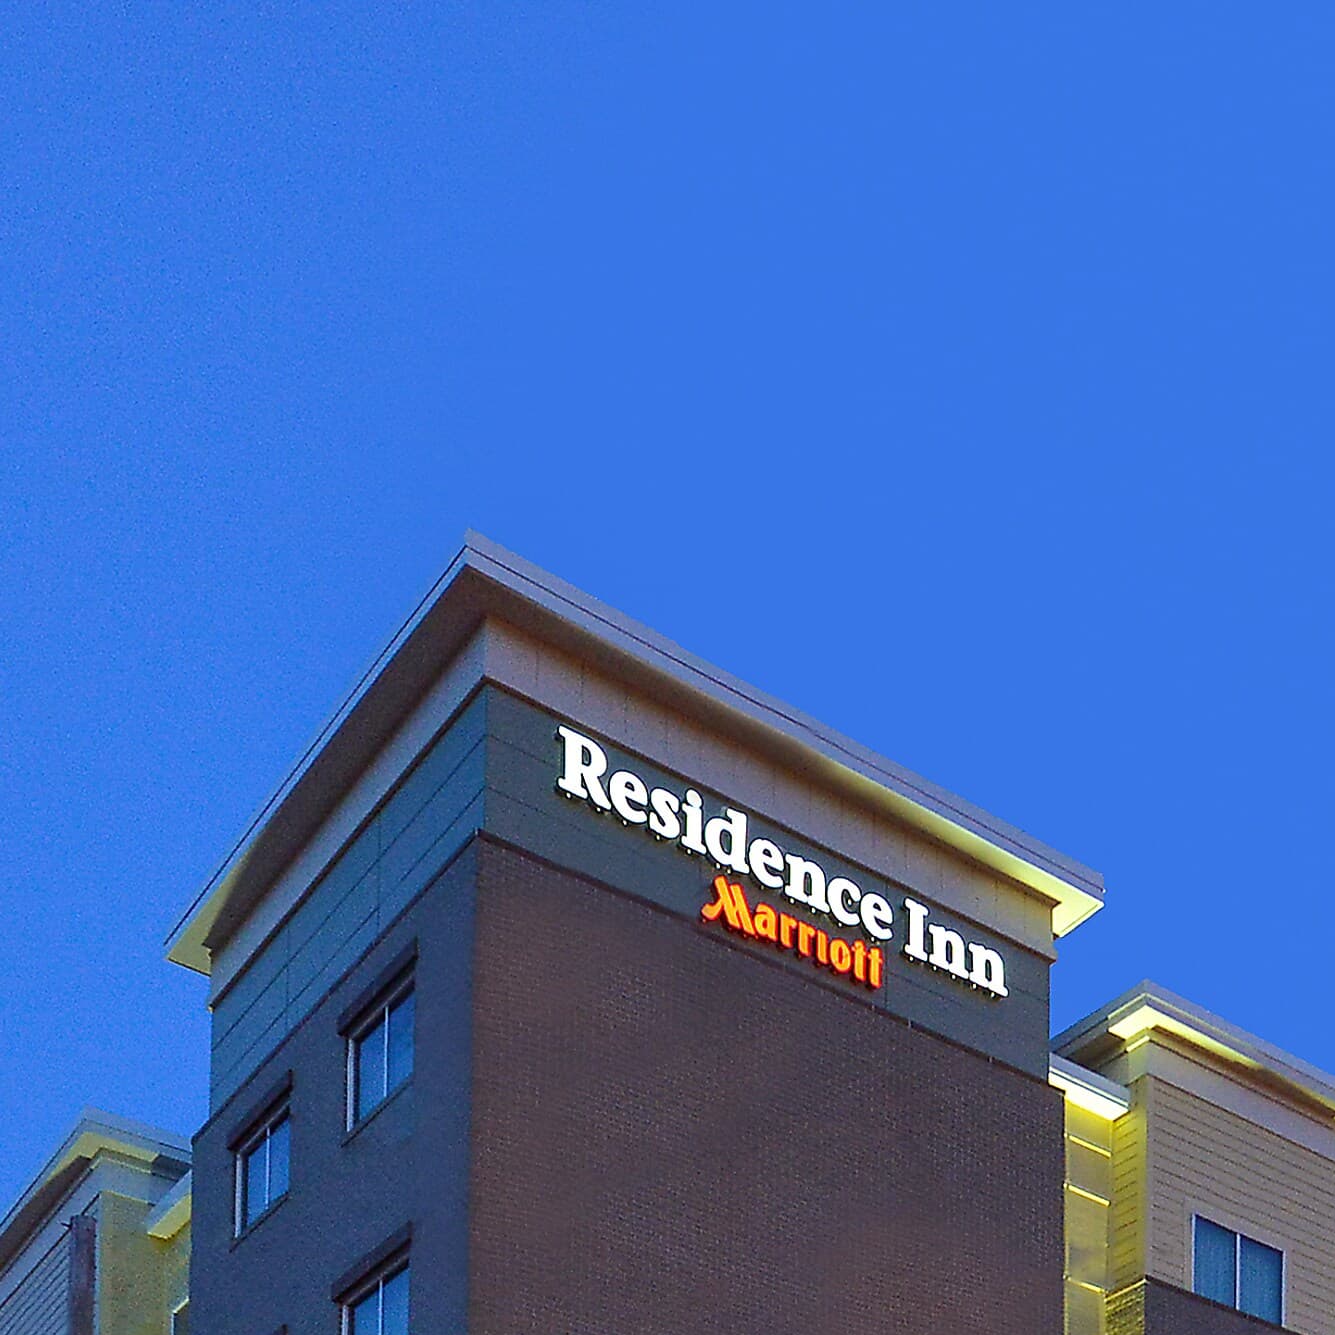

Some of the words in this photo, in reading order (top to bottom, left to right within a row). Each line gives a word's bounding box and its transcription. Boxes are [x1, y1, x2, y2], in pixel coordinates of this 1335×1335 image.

[557, 725, 894, 940] Residence
[904, 898, 1008, 997] Inn
[702, 876, 884, 989] Marriott
